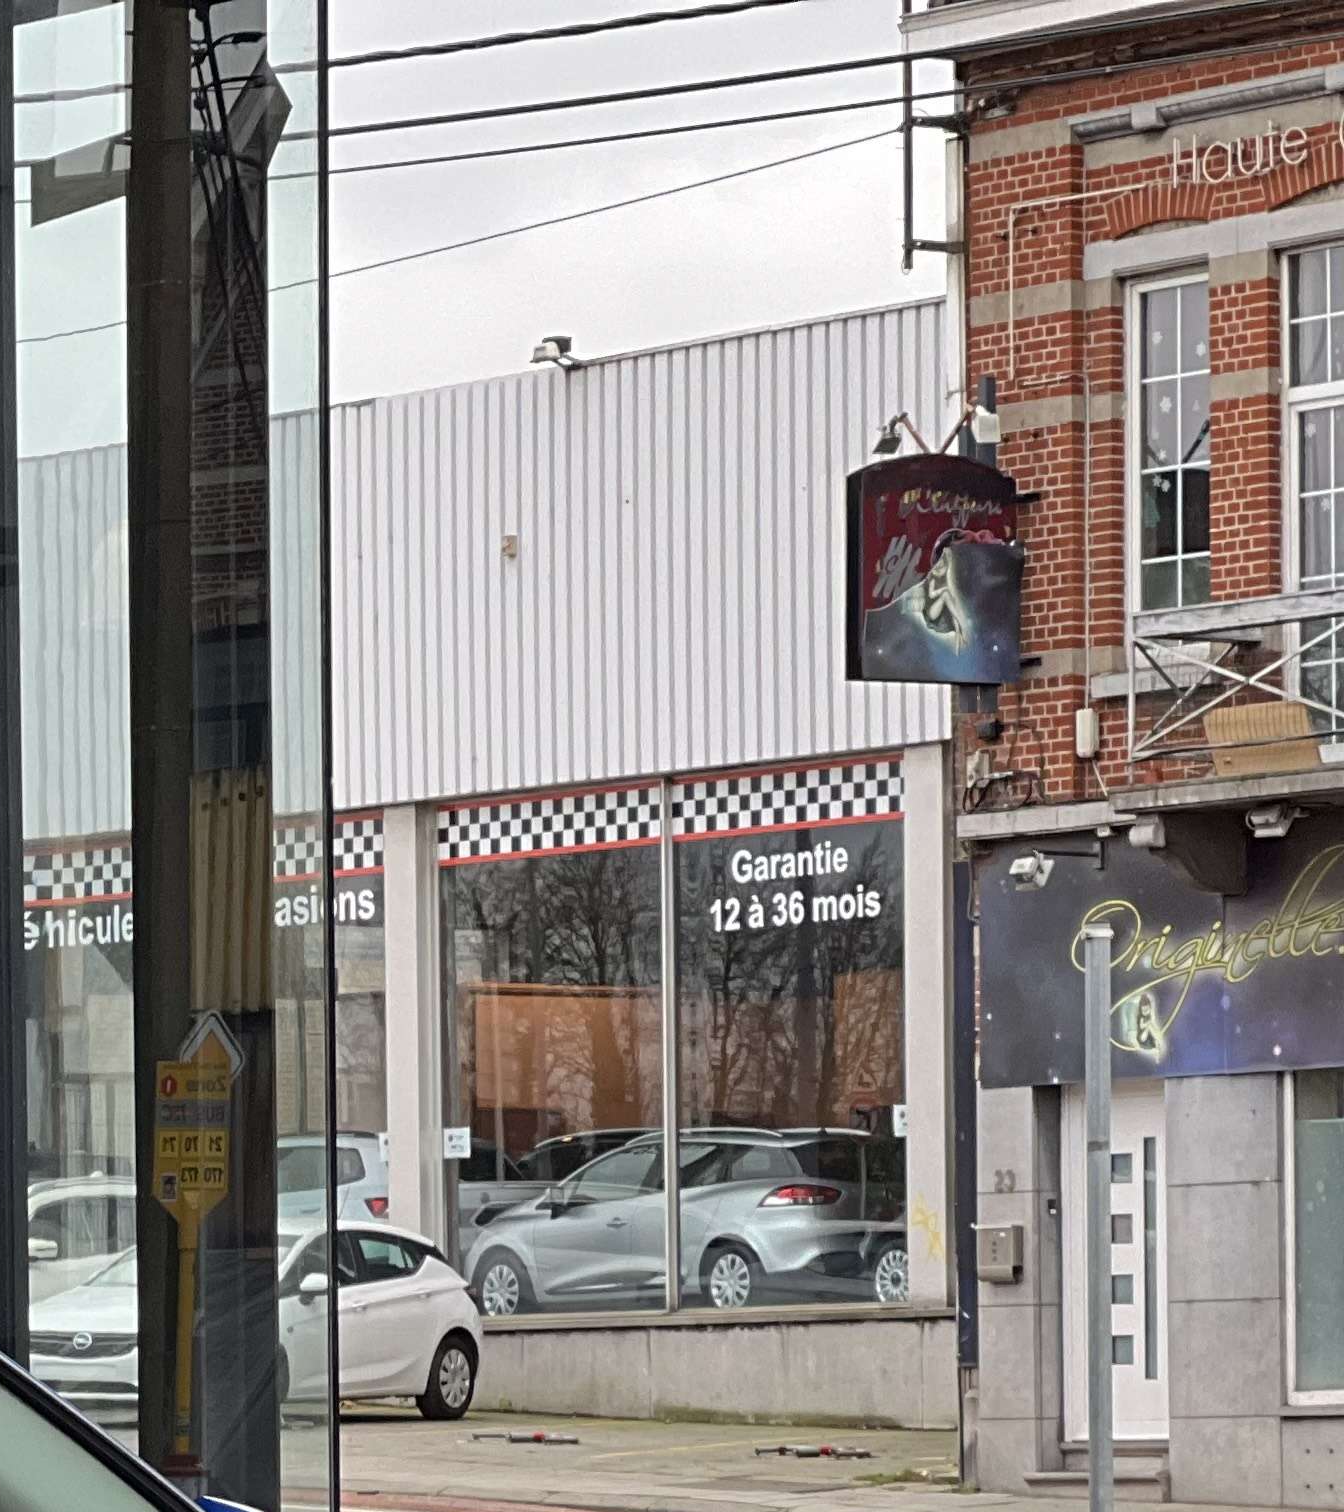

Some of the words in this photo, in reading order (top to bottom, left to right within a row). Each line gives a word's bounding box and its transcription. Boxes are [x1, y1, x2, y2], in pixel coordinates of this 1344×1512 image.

[1173, 120, 1308, 188] Haute
[732, 840, 849, 884] Garantie
[24, 904, 133, 951] éhicule
[274, 884, 376, 928] asions
[709, 896, 741, 933] 12
[748, 894, 765, 929] à
[772, 890, 805, 927] 36
[812, 883, 882, 923] mois
